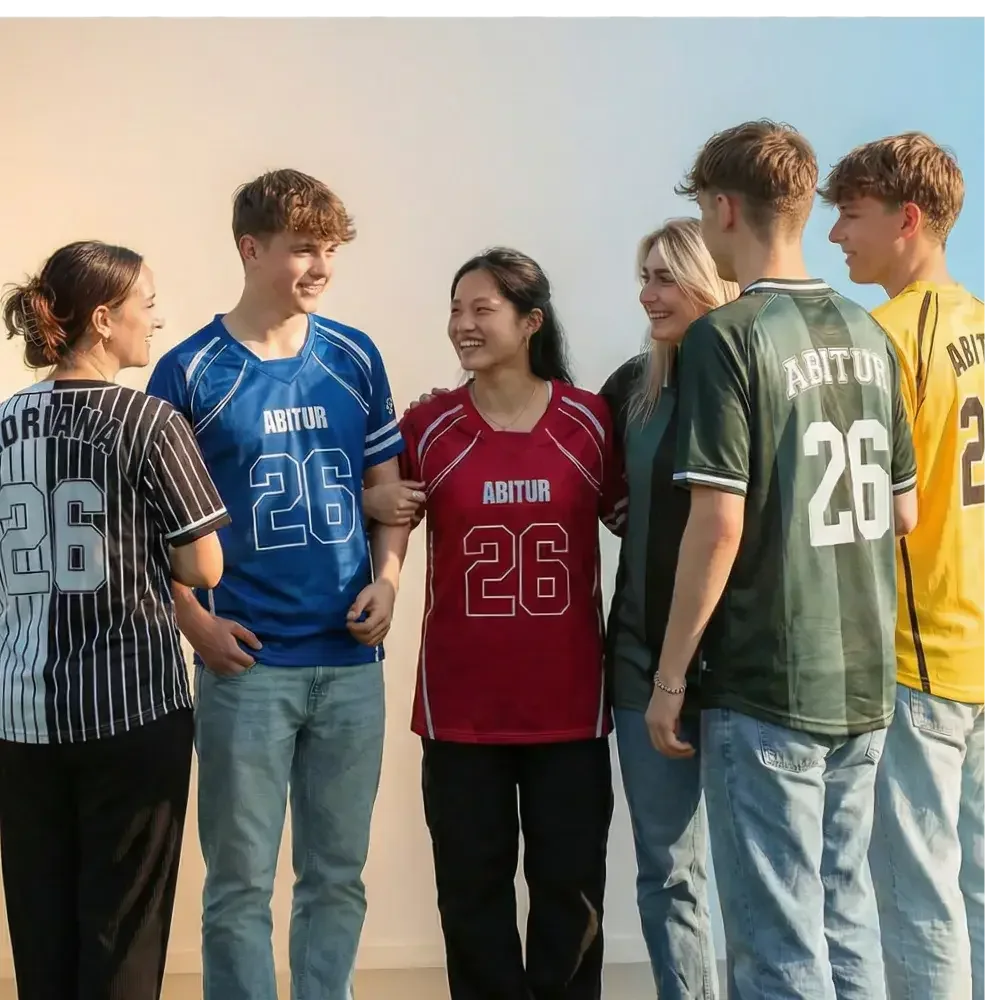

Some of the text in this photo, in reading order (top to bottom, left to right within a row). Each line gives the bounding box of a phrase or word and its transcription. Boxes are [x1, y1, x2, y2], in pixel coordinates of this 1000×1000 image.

[781, 347, 889, 401] ABITUR
[0, 404, 123, 457] DRIANA
[264, 406, 328, 435] ABITUR
[250, 448, 356, 551] 26
[482, 479, 551, 504] ABITUR
[803, 419, 889, 547] 26
[0, 479, 107, 597] 26
[463, 522, 570, 617] 26
